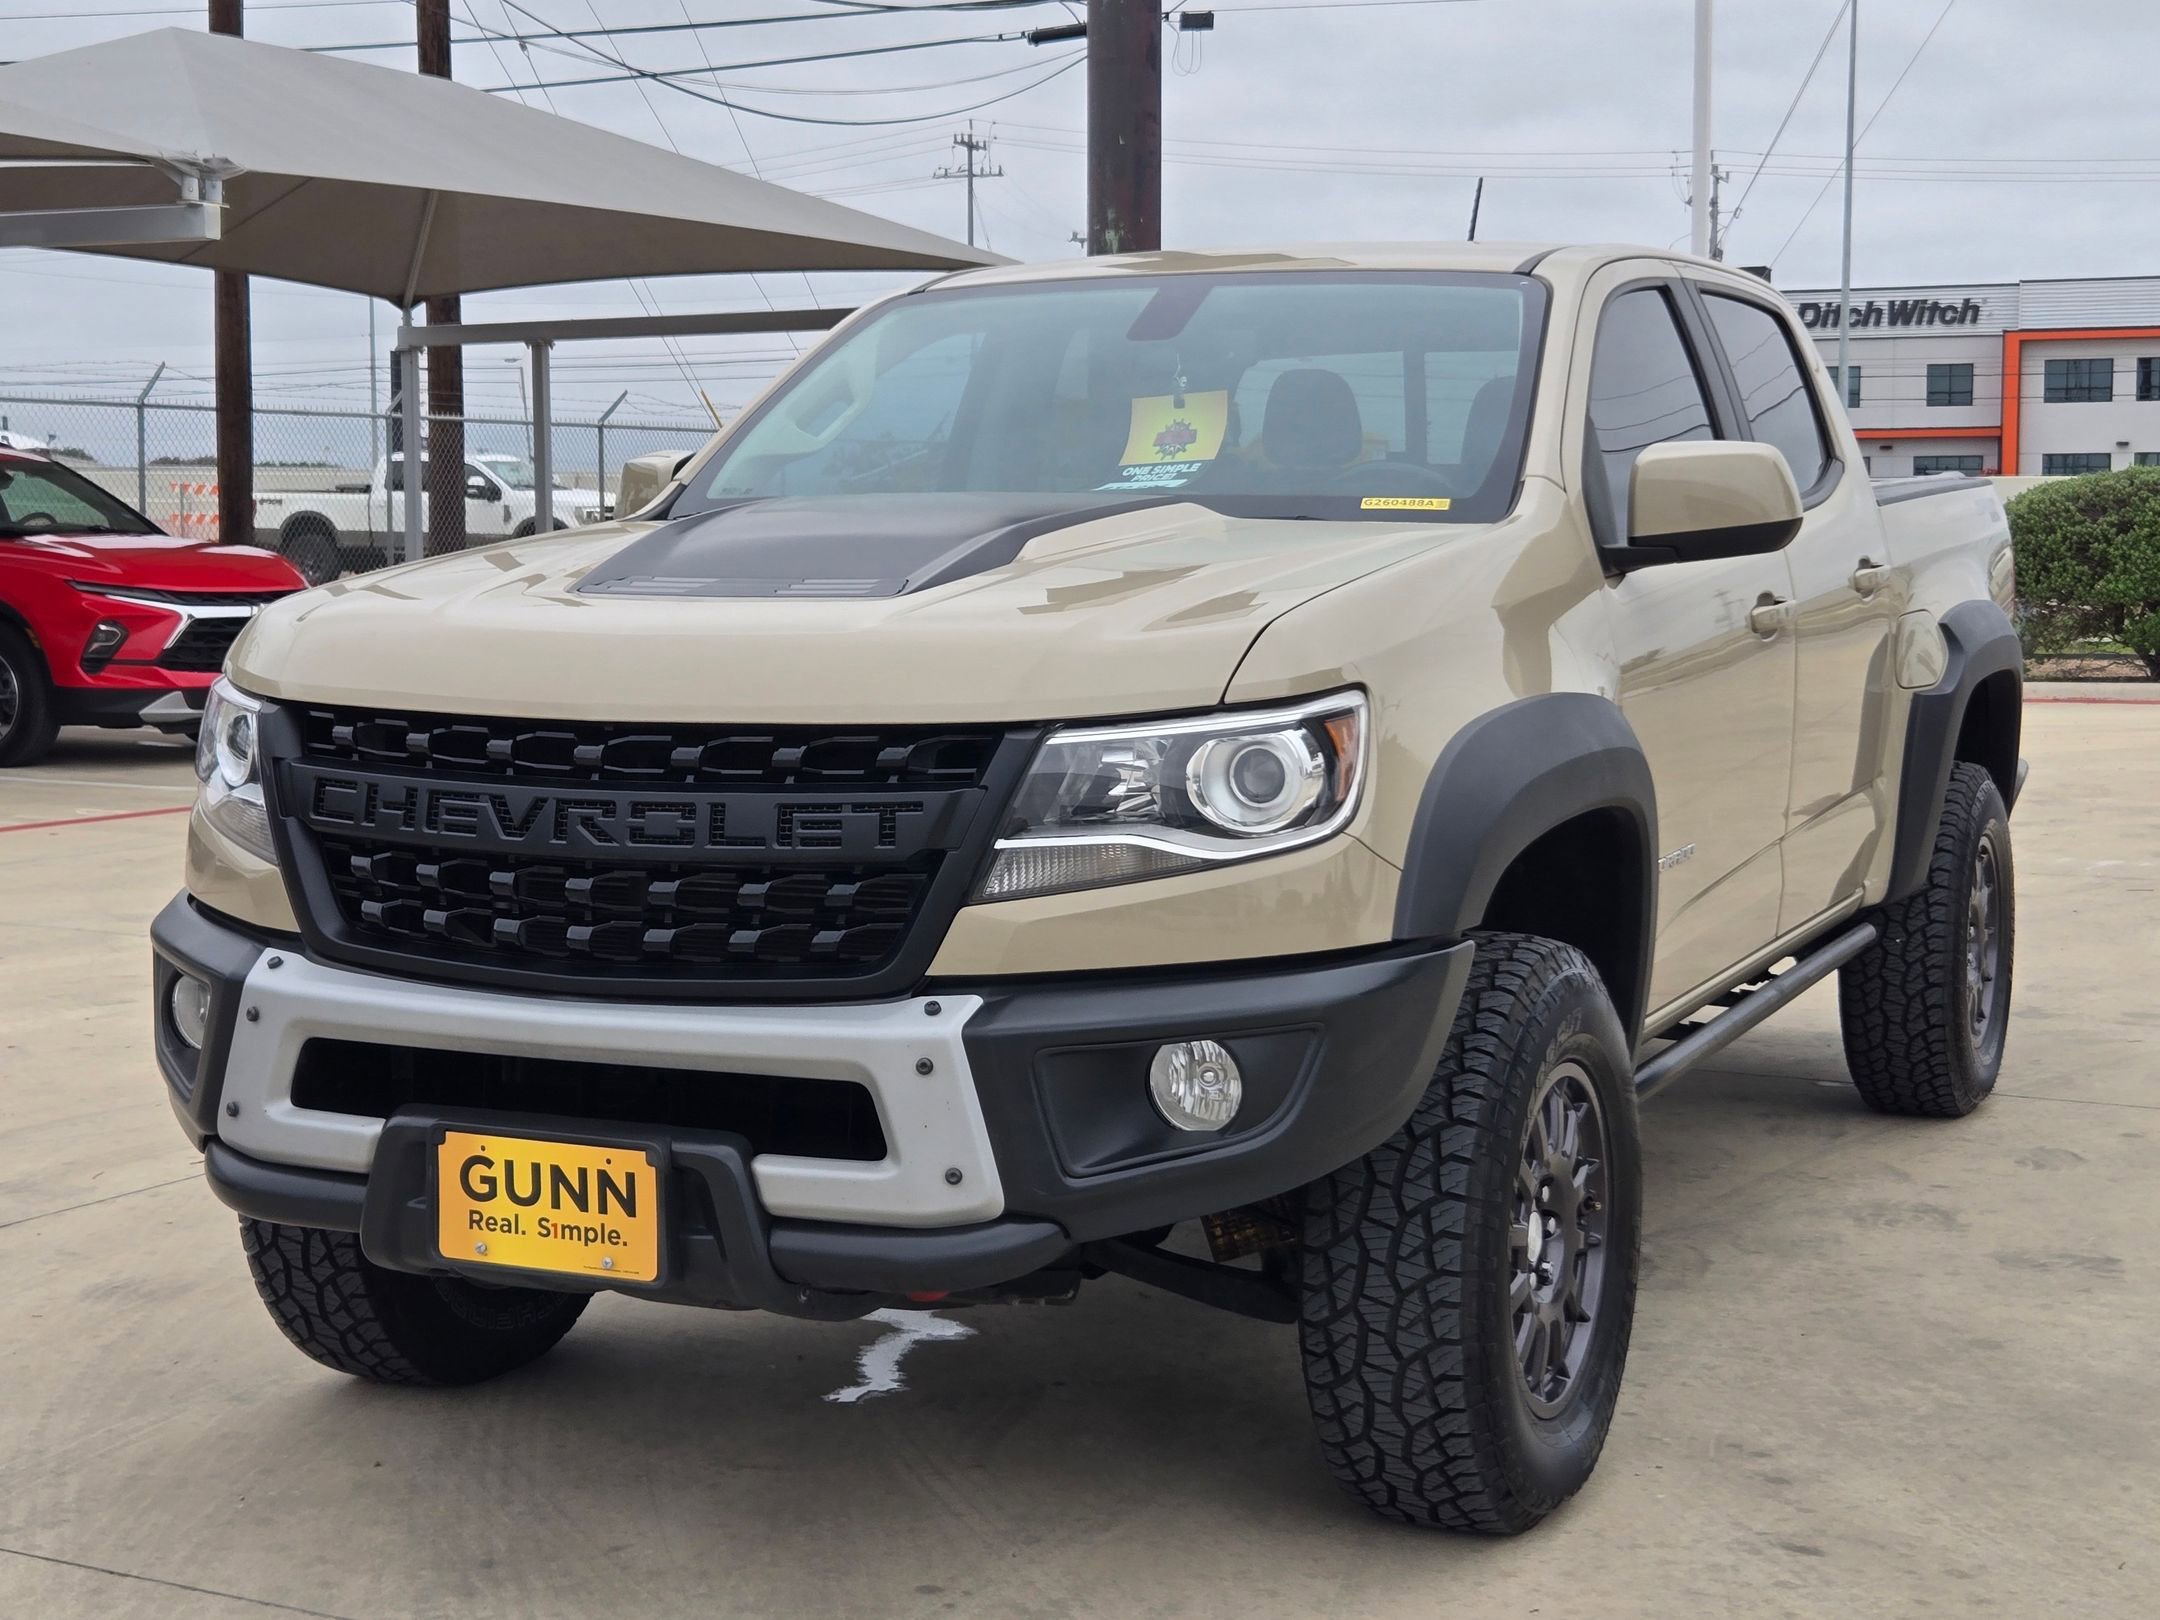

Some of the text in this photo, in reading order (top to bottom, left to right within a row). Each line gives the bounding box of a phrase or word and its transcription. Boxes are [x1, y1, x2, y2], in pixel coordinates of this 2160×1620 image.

[1887, 298, 1980, 326] Witch
[1122, 463, 1202, 476] ONE SIMPLE
[310, 775, 925, 850] CHEVROLET
[459, 1155, 637, 1218] GUNN
[468, 1209, 526, 1235] Real.
